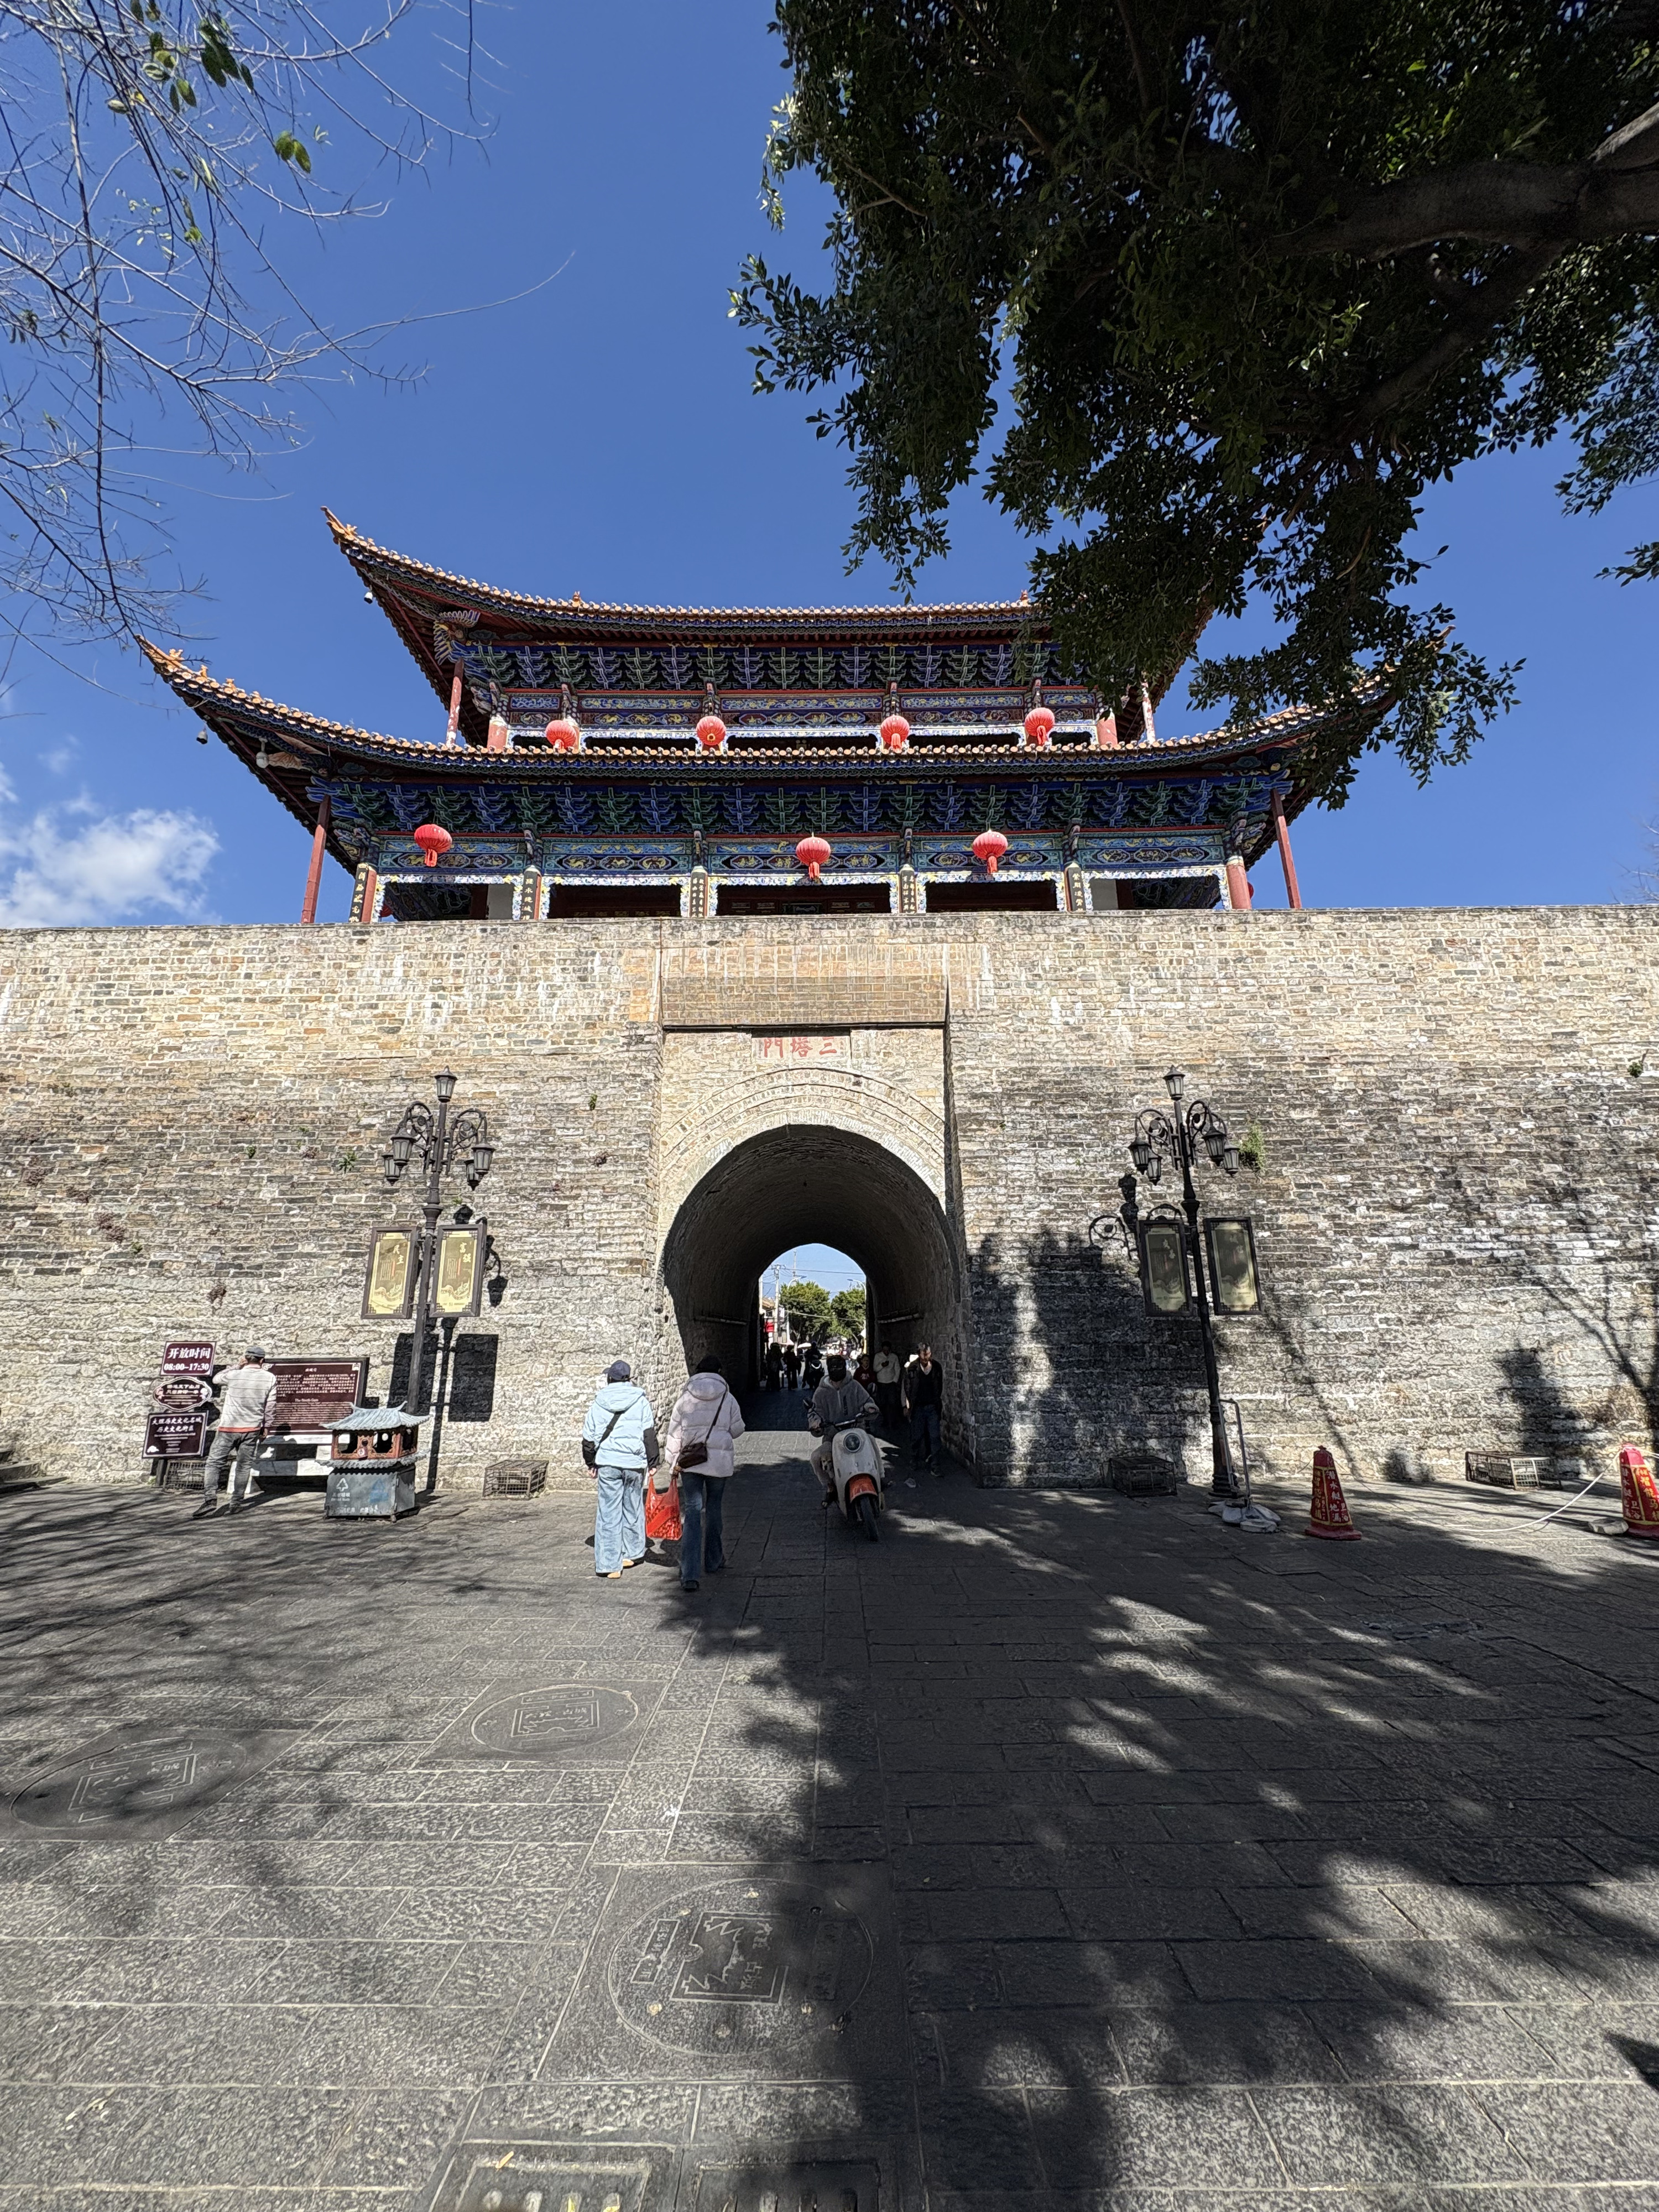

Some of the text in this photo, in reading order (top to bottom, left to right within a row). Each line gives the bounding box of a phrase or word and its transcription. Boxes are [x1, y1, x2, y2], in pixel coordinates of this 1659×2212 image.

[393, 1244, 404, 1265] 民主
[460, 1242, 471, 1262] 富强
[167, 1348, 211, 1359] 开放时间
